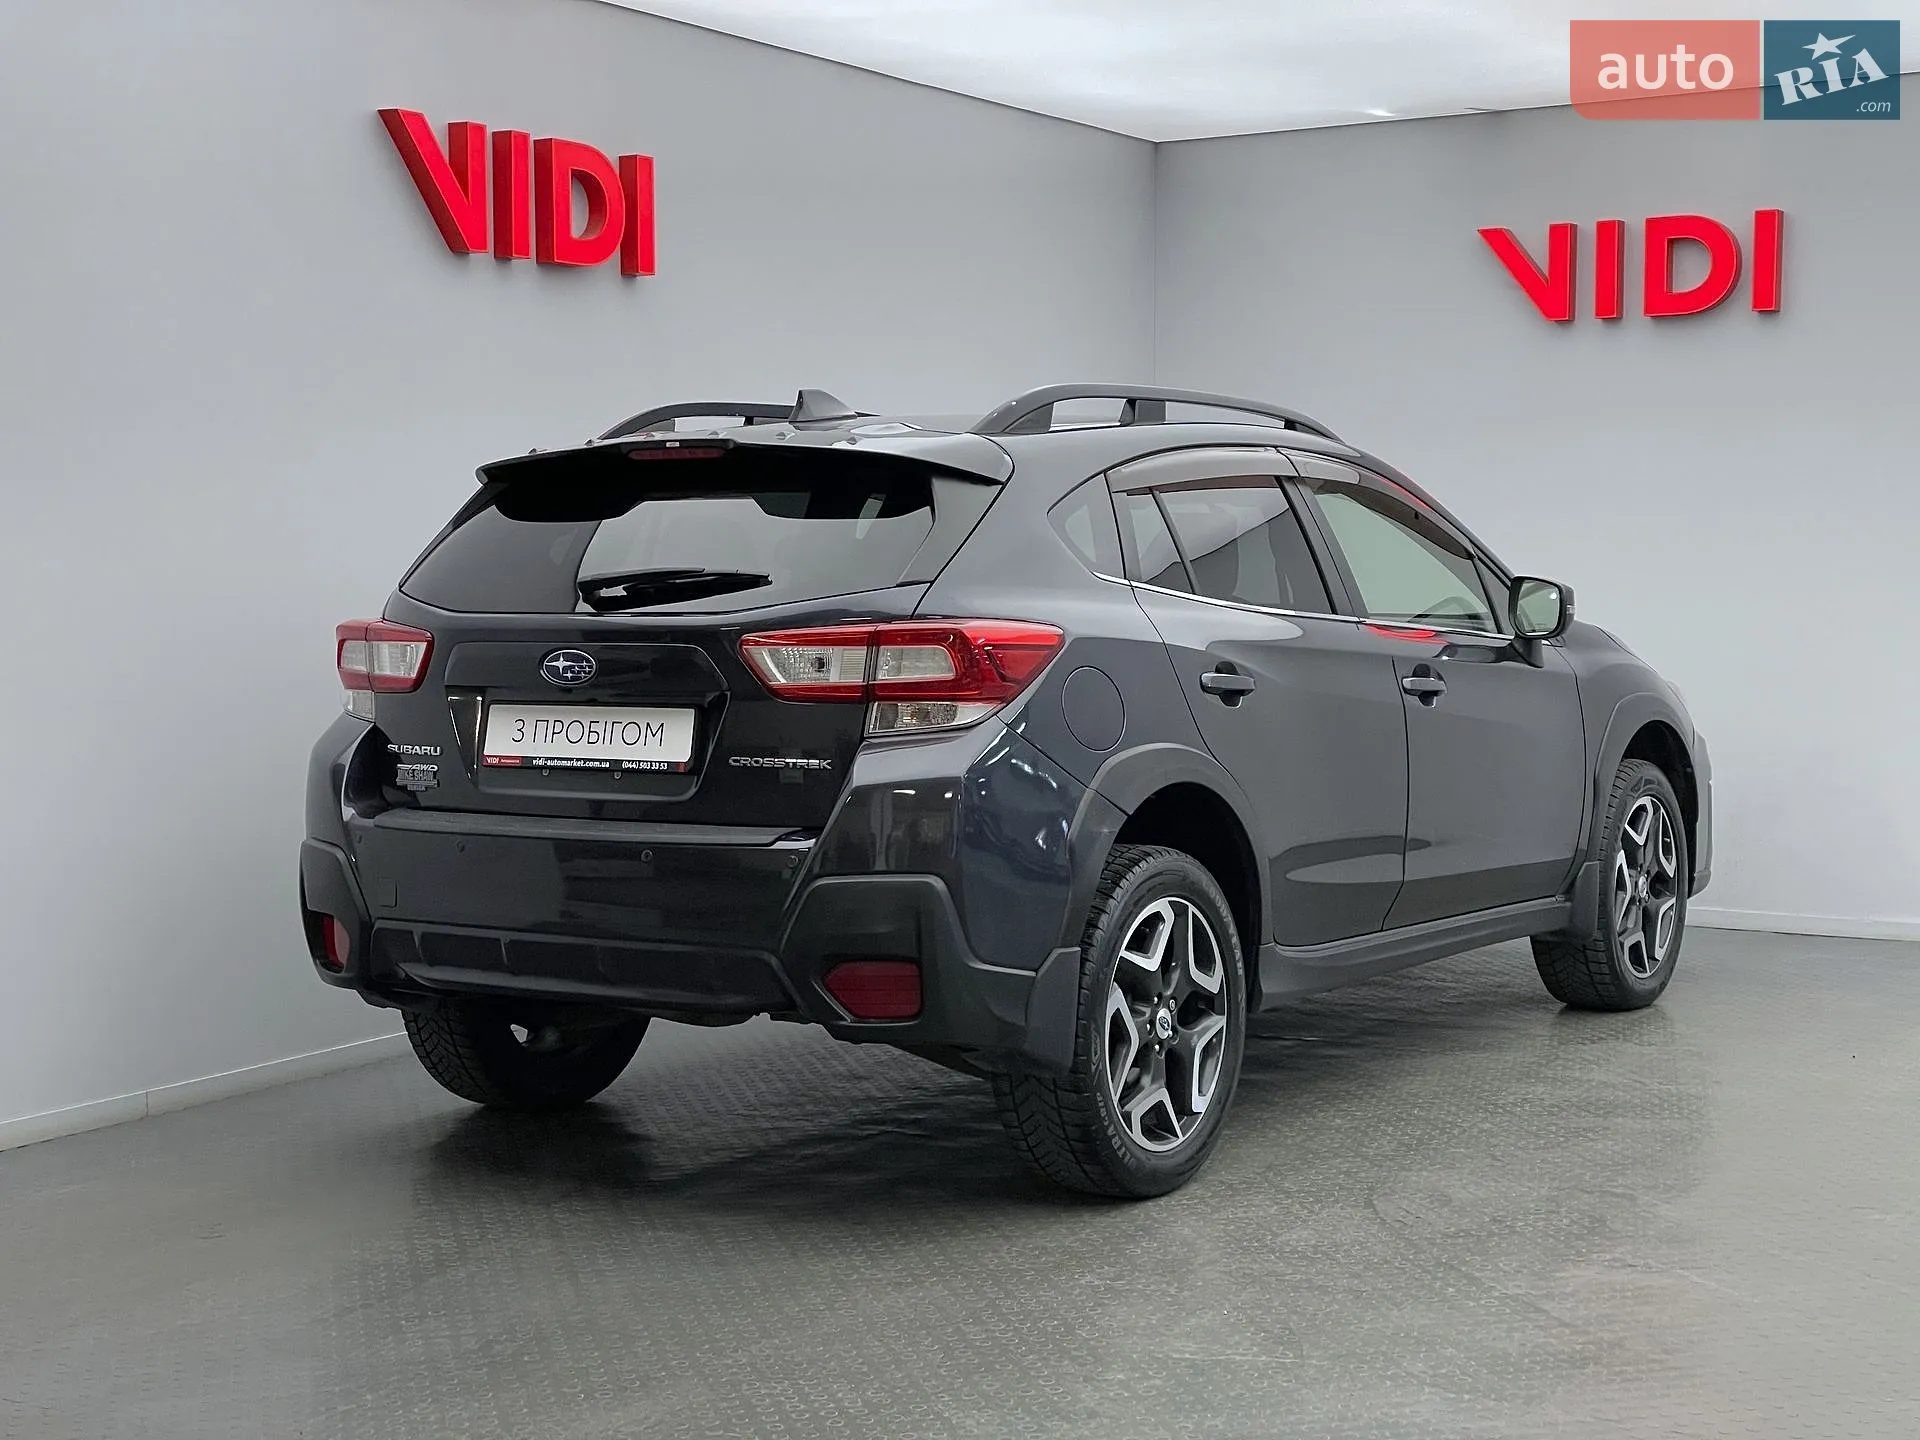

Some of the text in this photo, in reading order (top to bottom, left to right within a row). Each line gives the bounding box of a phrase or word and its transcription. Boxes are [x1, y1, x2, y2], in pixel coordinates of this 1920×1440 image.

[376, 107, 656, 277] VIDI
[1477, 208, 1784, 321] VIDI
[533, 719, 665, 747] ПРОБІГОМ
[387, 744, 440, 756] SUBARU
[532, 757, 610, 768] vidi-automarket.com.ua
[728, 756, 832, 769] CROSSTREK
